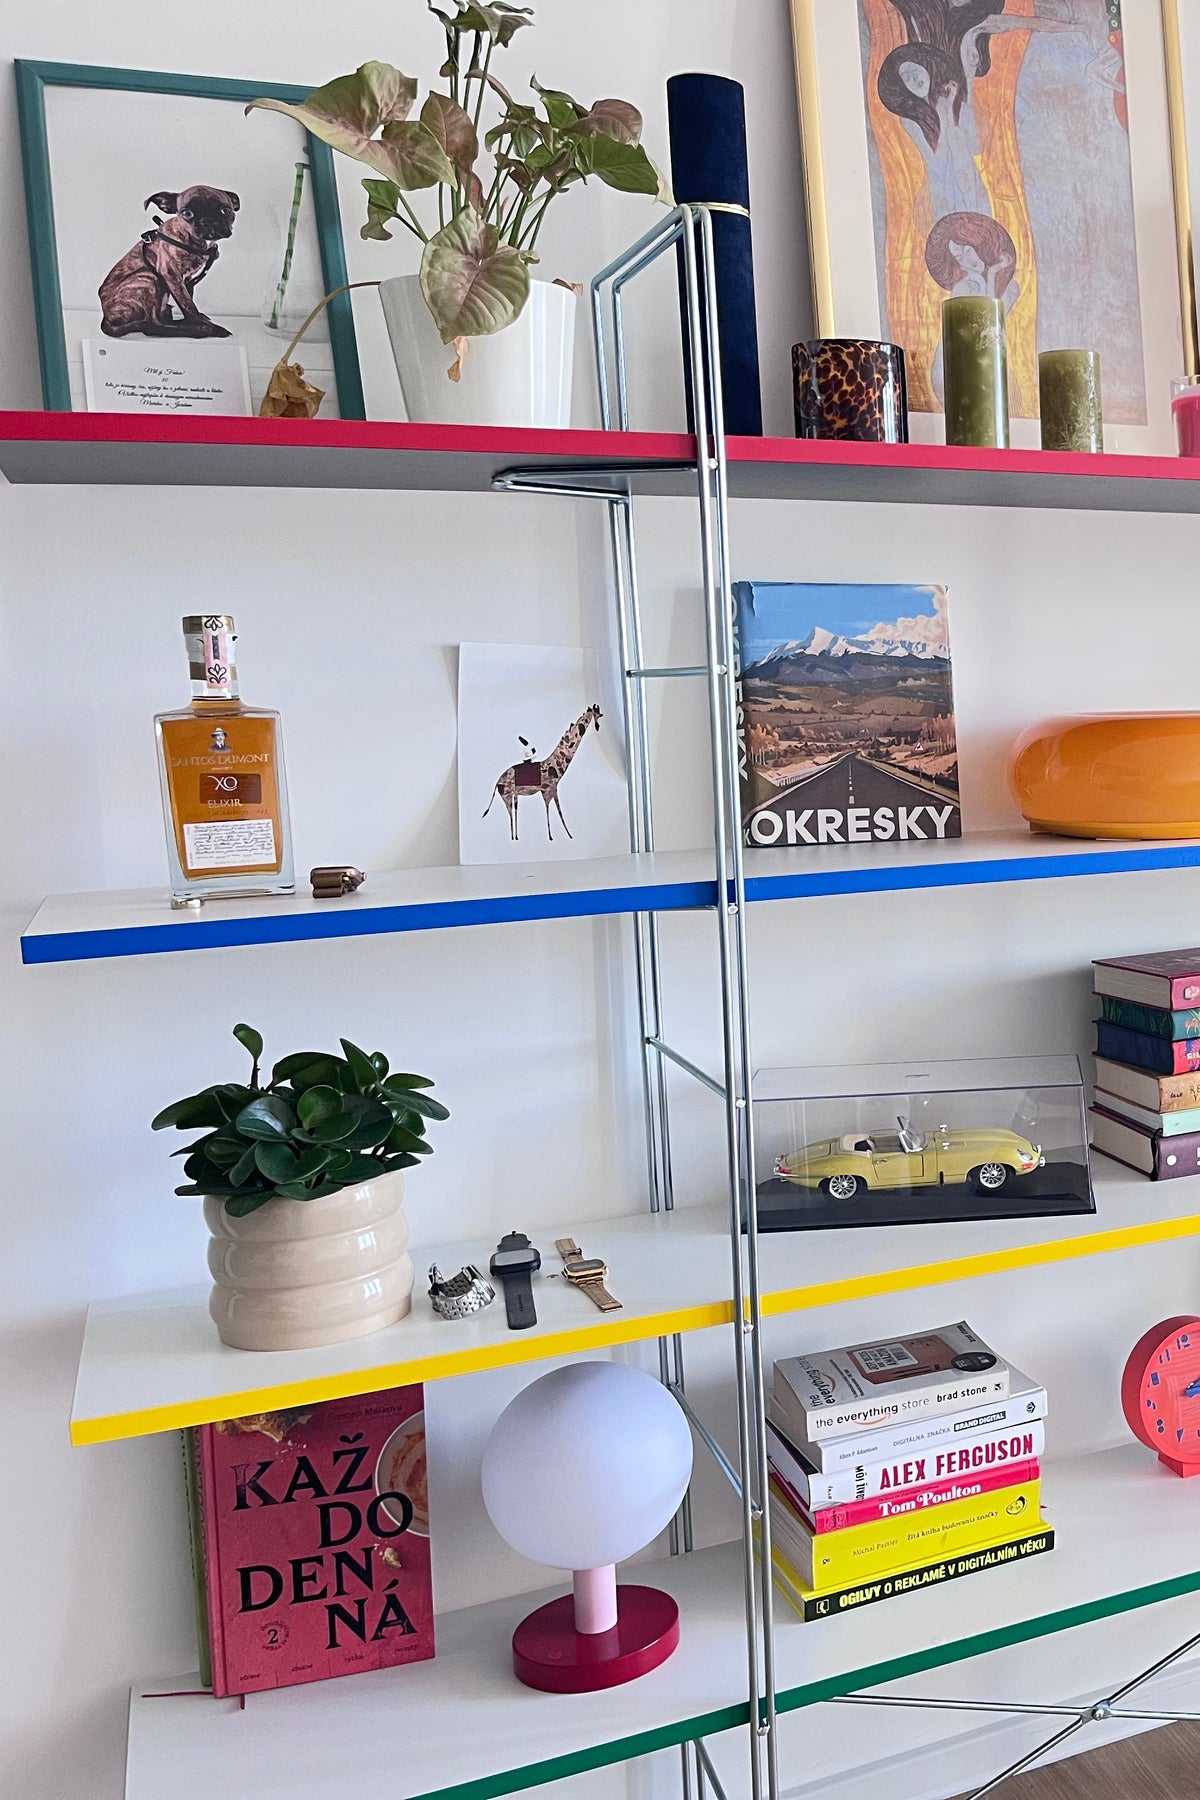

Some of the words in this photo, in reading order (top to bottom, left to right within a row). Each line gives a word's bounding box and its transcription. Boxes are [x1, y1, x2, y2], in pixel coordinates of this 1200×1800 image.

[218, 753, 269, 765] DUMONT
[207, 798, 242, 808] ELIXIR
[751, 805, 953, 845] OKRESKY
[807, 1369, 836, 1404] everything
[816, 1415, 833, 1428] the
[836, 1403, 899, 1425] everything
[901, 1397, 930, 1410] store
[936, 1391, 958, 1403] brad
[960, 1385, 988, 1398] stone
[954, 1418, 979, 1432] BRAND
[979, 1412, 1005, 1425] DIGITAL
[892, 1433, 925, 1447] DIGITÁLNA
[927, 1426, 951, 1438] ZNAČKA
[231, 1432, 373, 1511] KAŽ
[879, 1458, 925, 1490] ALEX
[936, 1433, 1033, 1475] FERGUSON
[878, 1501, 916, 1517] Tom
[916, 1484, 981, 1508] Poulton
[315, 1491, 414, 1549] DO
[921, 1525, 941, 1537] kniha
[941, 1517, 976, 1532] budovania
[976, 1509, 999, 1522] značky
[852, 1545, 875, 1557] Michal
[235, 1545, 377, 1614] DEN
[839, 1584, 882, 1608] OGILVY
[884, 1582, 892, 1594] O
[894, 1565, 946, 1591] REKLAMĚ
[948, 1563, 956, 1576] V
[957, 1546, 1018, 1573] DIGITÁLNÍM
[1019, 1537, 1047, 1556] VĚKU
[324, 1578, 418, 1650] NÁ
[267, 1628, 279, 1644] 2
